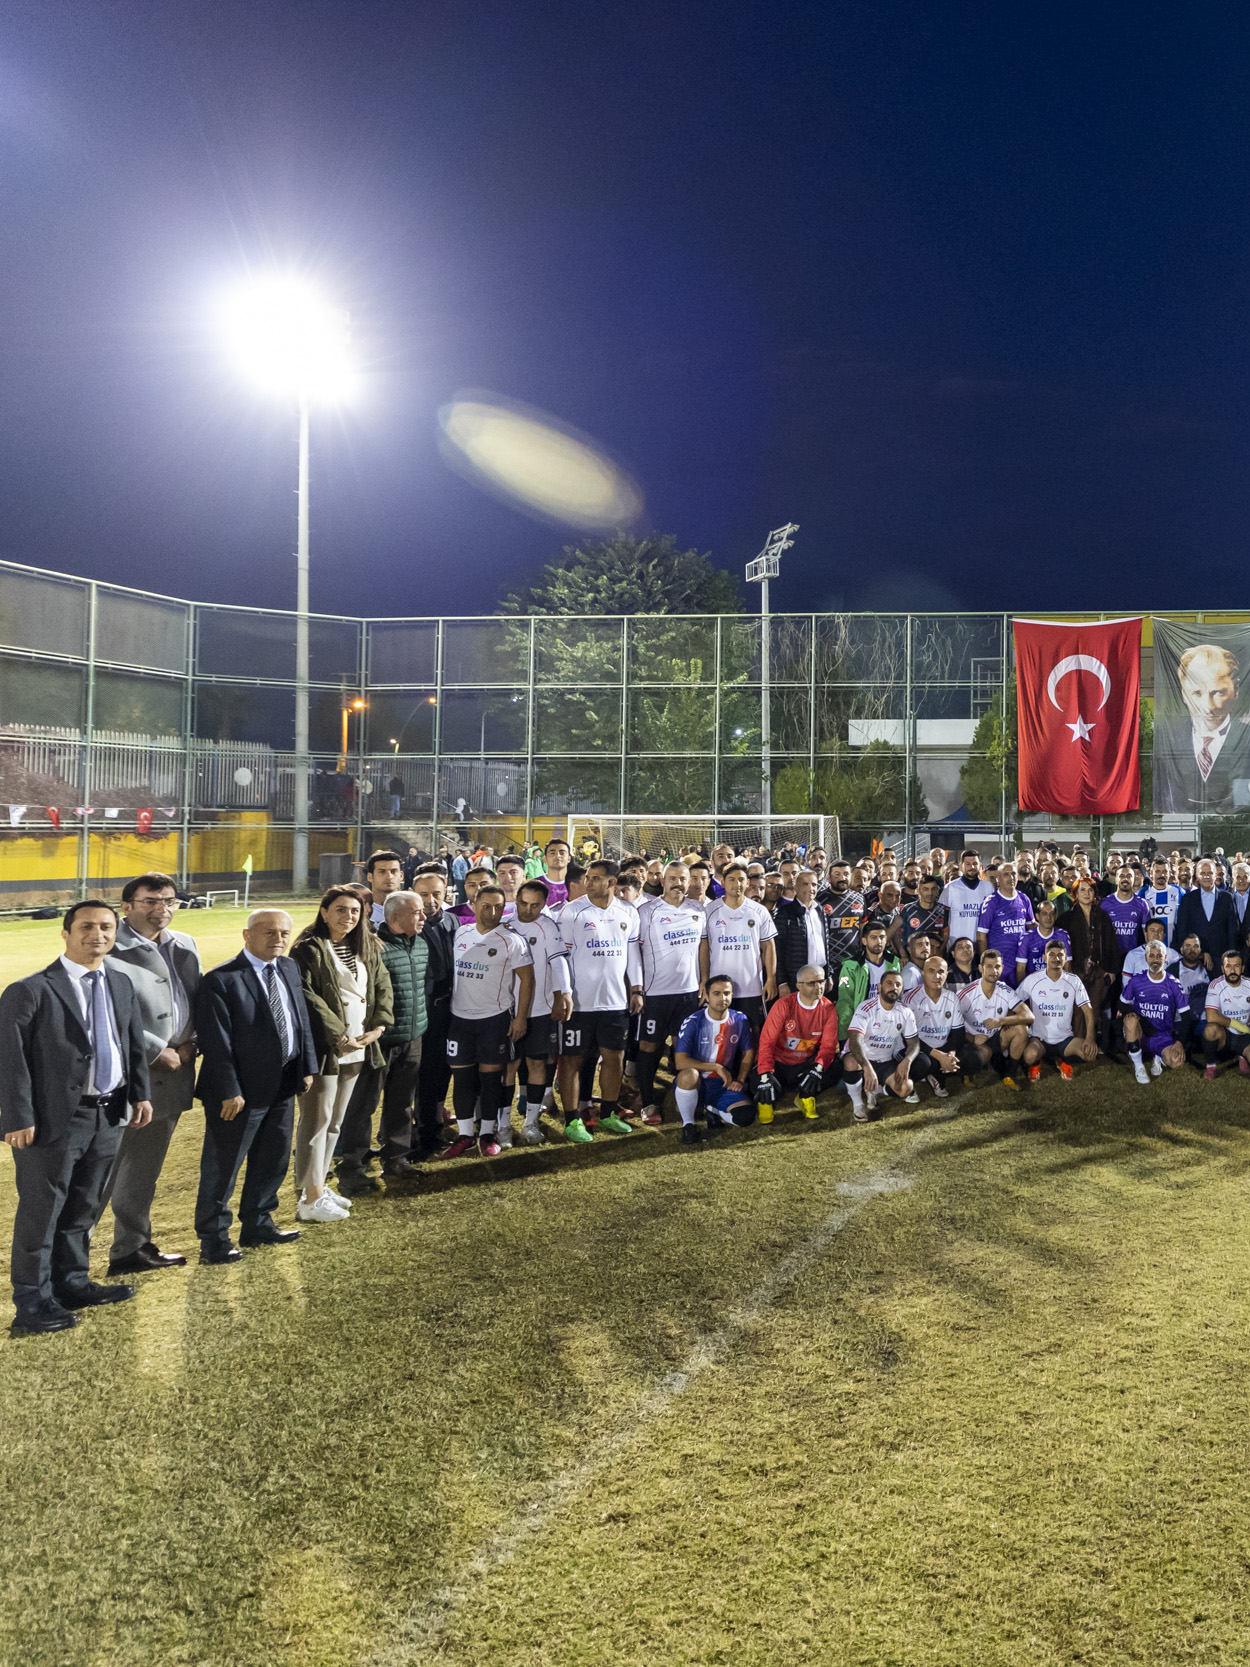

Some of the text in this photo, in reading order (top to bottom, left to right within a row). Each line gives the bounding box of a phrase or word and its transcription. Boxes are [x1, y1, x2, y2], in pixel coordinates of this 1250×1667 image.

[964, 903, 980, 911] MAZL
[663, 931, 685, 941] class
[718, 934, 737, 943] class
[586, 938, 610, 949] class
[466, 971, 475, 979] 22
[1038, 1003, 1054, 1011] class
[1139, 1002, 1169, 1012] KÜLTÜR
[1141, 1010, 1164, 1020] SANAT
[647, 1019, 656, 1035] 9
[565, 1030, 581, 1047] 31
